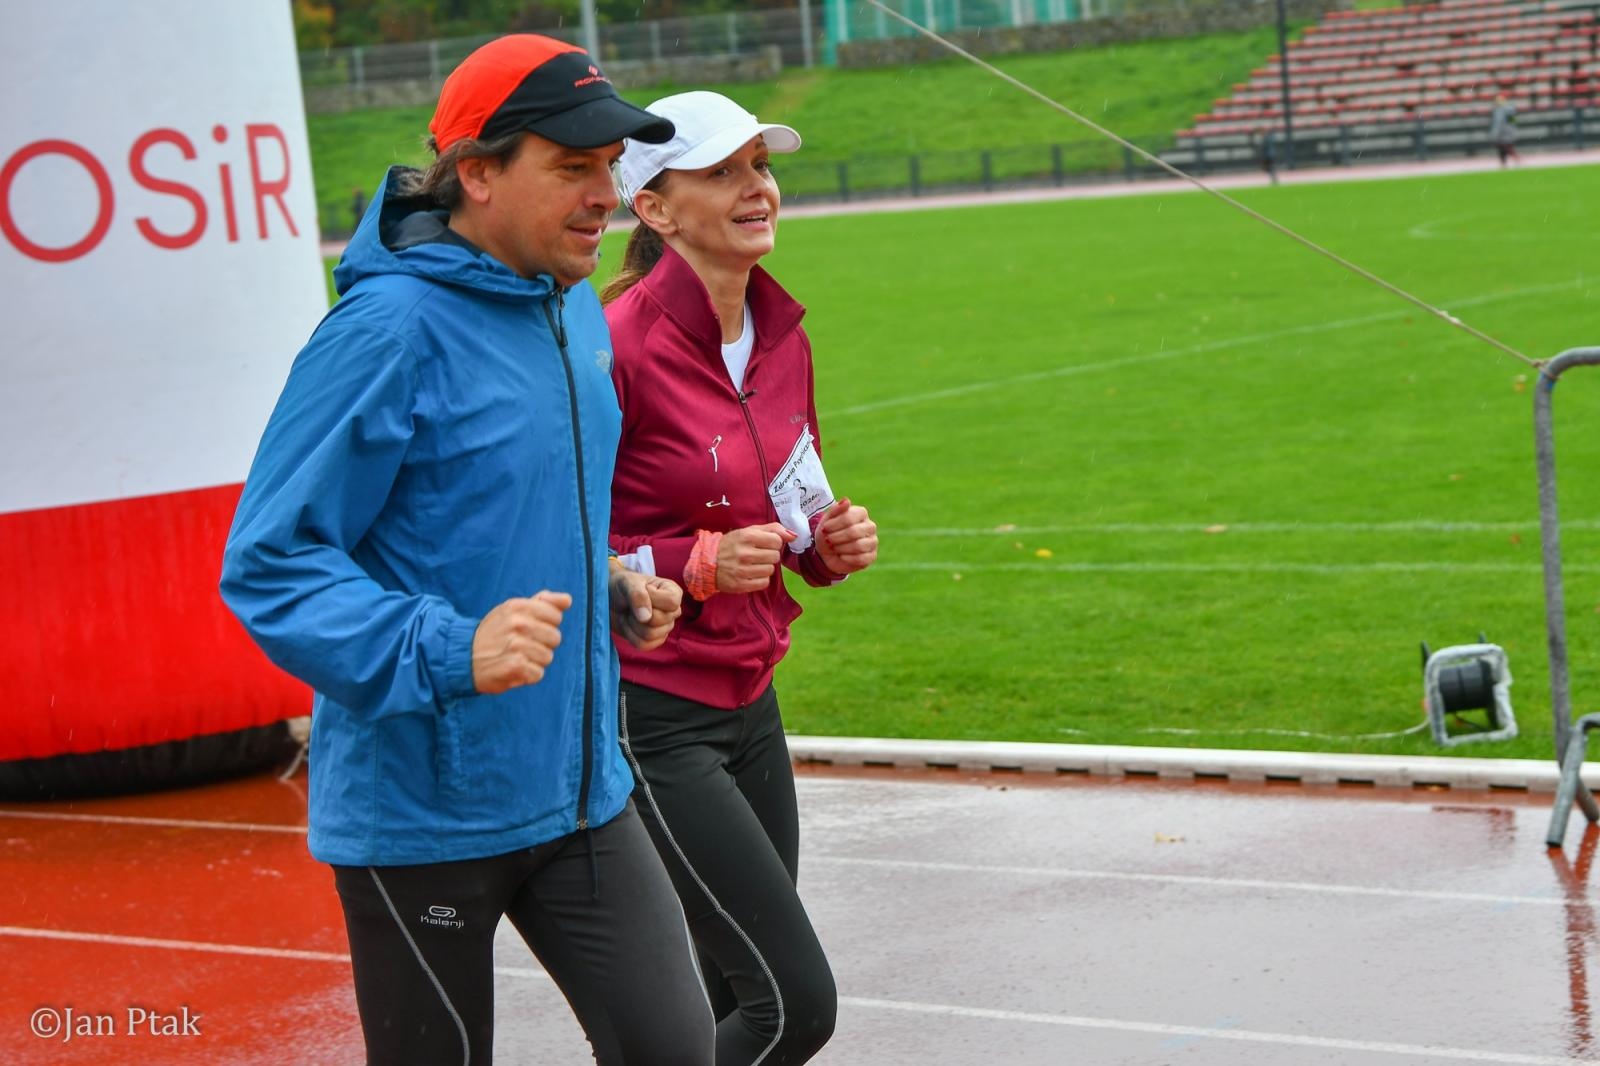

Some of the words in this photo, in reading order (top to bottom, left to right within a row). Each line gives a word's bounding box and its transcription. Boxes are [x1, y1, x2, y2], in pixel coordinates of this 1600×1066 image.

[0, 123, 300, 263] OSiR
[773, 467, 796, 493] Zdrowia
[420, 915, 464, 928] Kalenji
